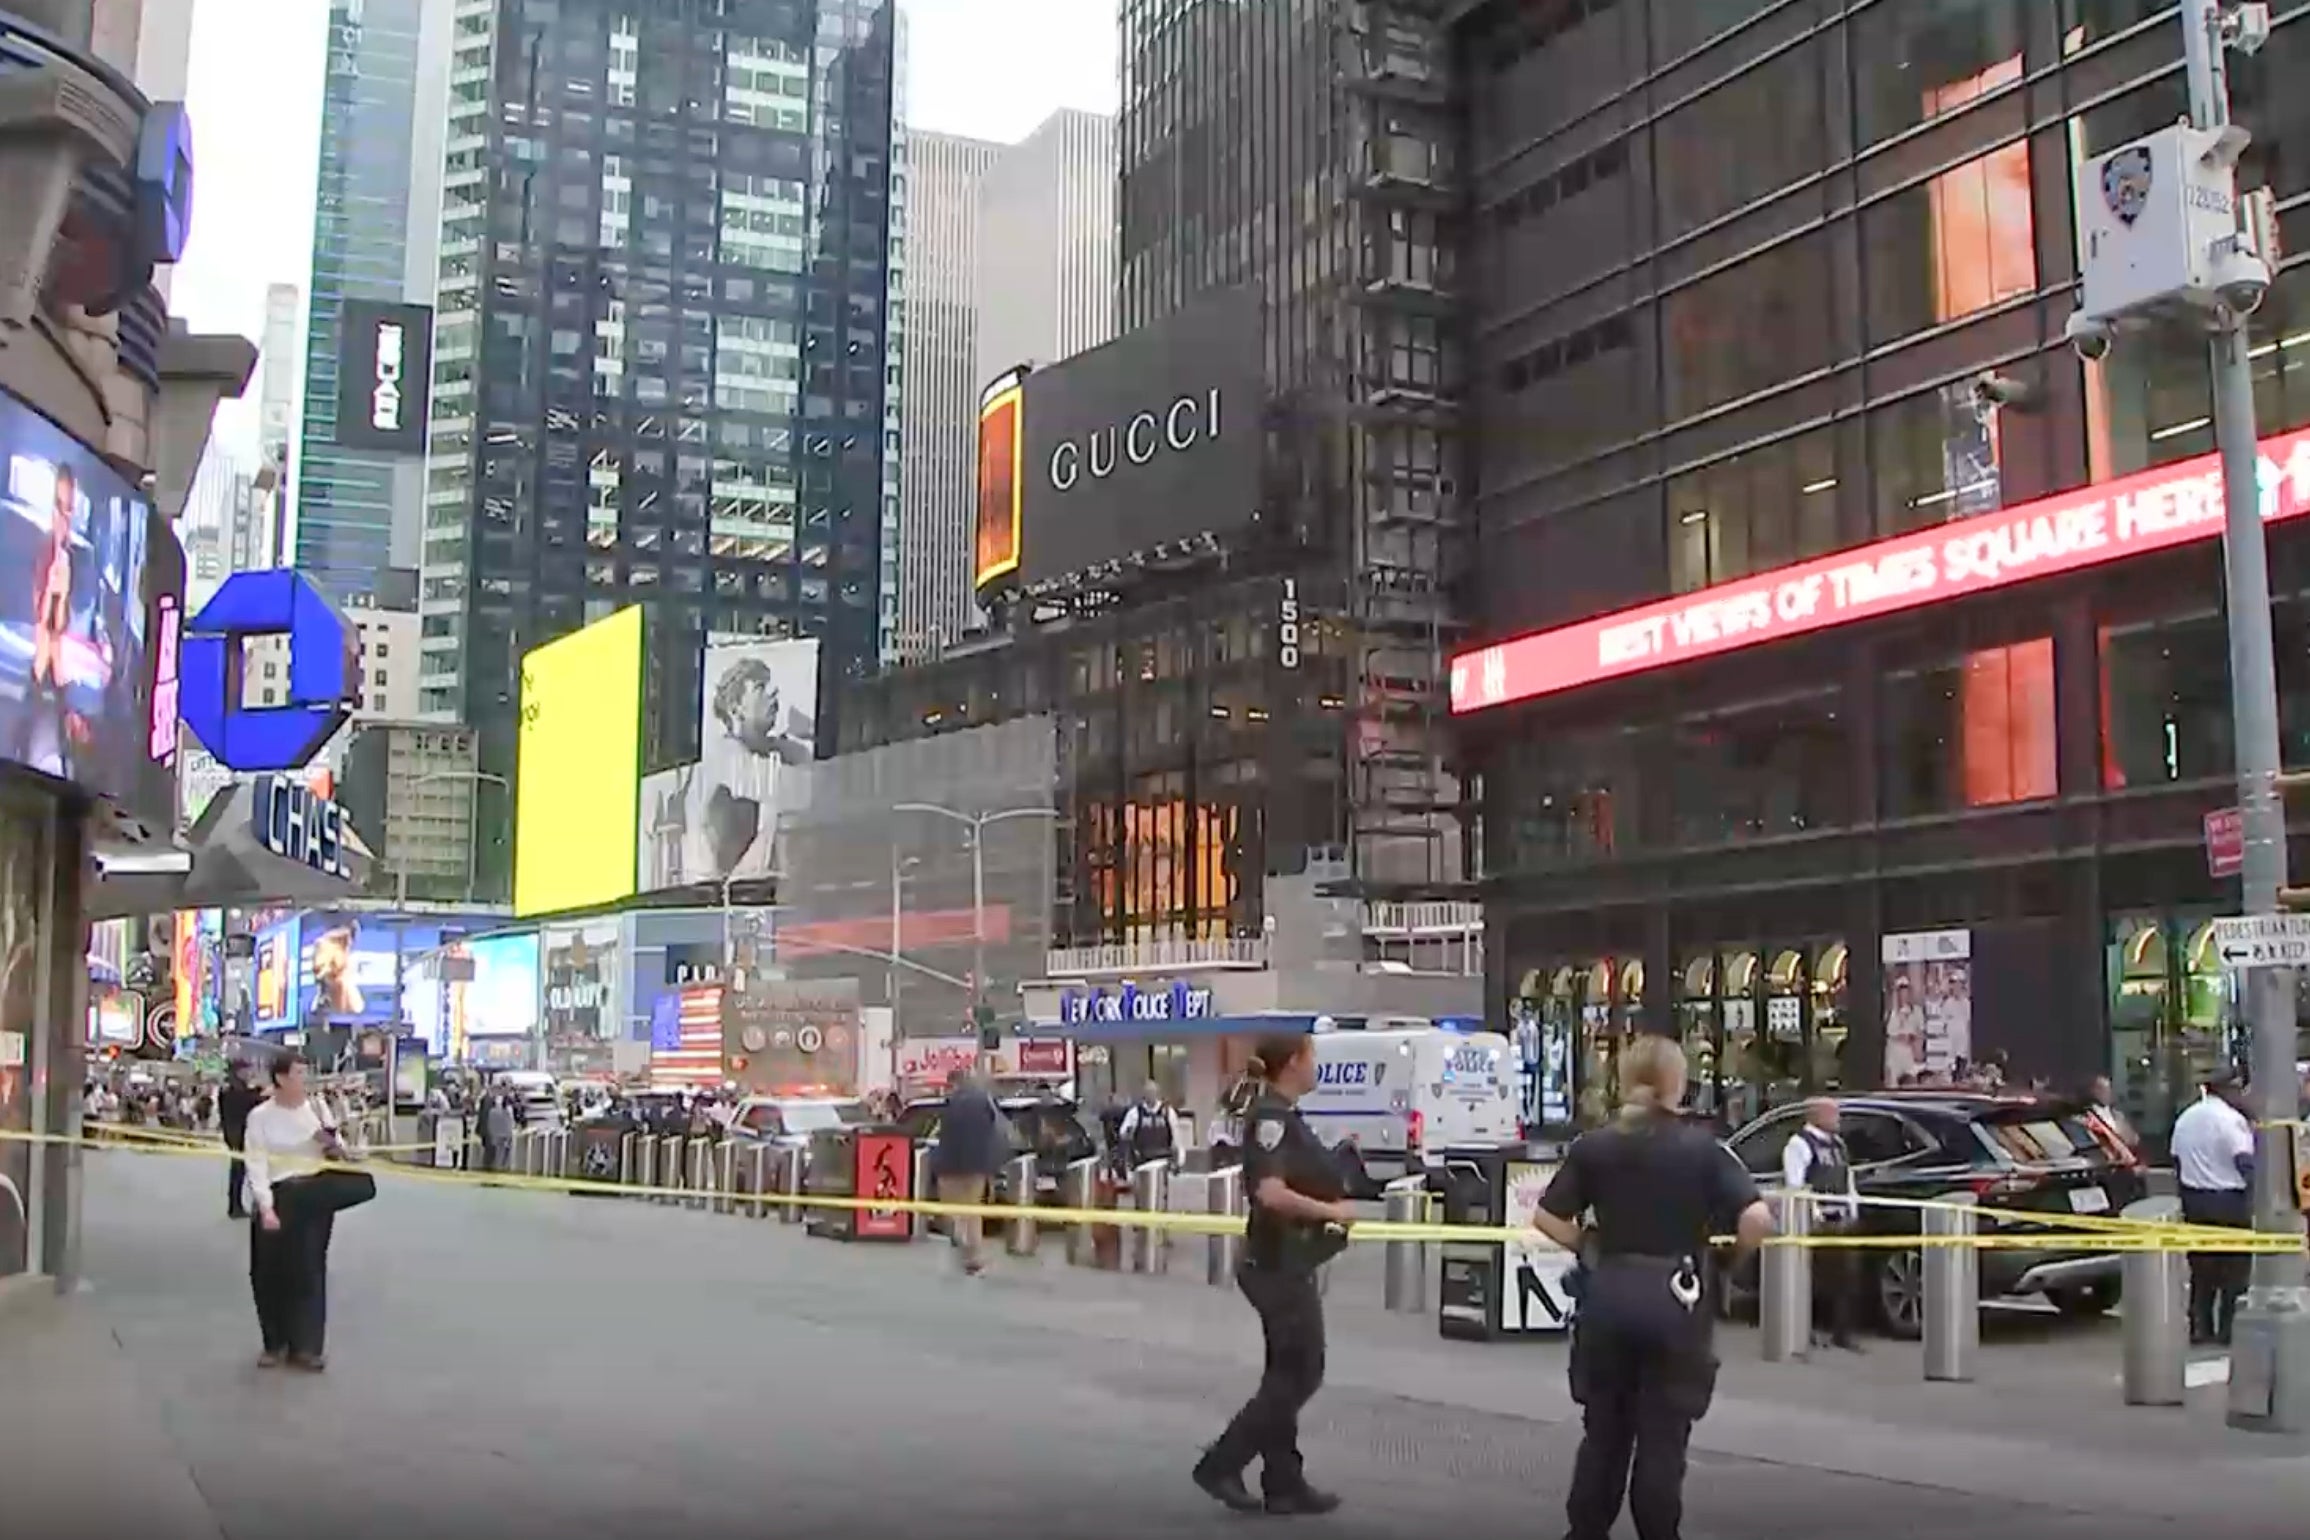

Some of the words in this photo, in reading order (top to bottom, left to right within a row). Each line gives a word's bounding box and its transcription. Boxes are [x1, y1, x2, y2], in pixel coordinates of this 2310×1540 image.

[1051, 388, 1220, 491] GUCCI
[1599, 617, 1666, 667] BEST
[1671, 589, 1772, 646] VIEWS
[1777, 575, 1823, 622] OF
[1828, 546, 1936, 607] TIMES
[1943, 501, 2107, 580] SQUARE
[2116, 470, 2223, 540] HERE
[1281, 579, 1299, 669] 1500
[268, 775, 351, 877] CHASE
[1317, 1062, 1368, 1084] OLICE
